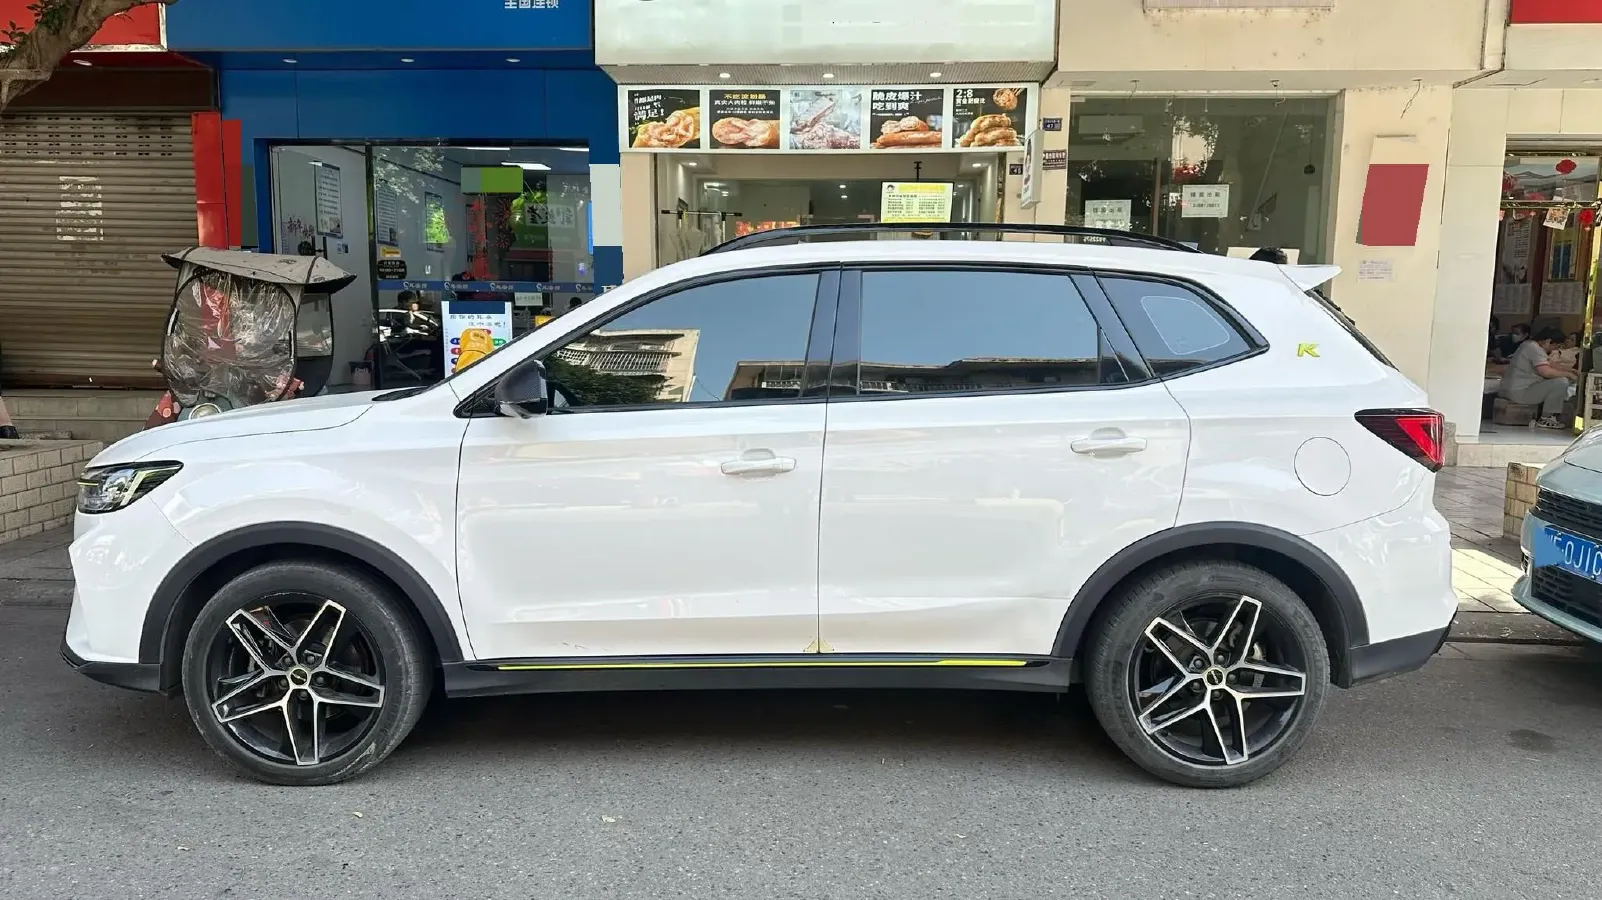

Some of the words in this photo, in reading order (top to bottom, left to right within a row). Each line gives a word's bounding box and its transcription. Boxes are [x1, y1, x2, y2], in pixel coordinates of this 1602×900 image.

[504, 0, 559, 9] 全国连锁
[872, 91, 922, 100] 脆皮爆汁
[956, 89, 973, 98] 2:8
[872, 101, 909, 110] 吃到爽
[1297, 343, 1320, 358] K
